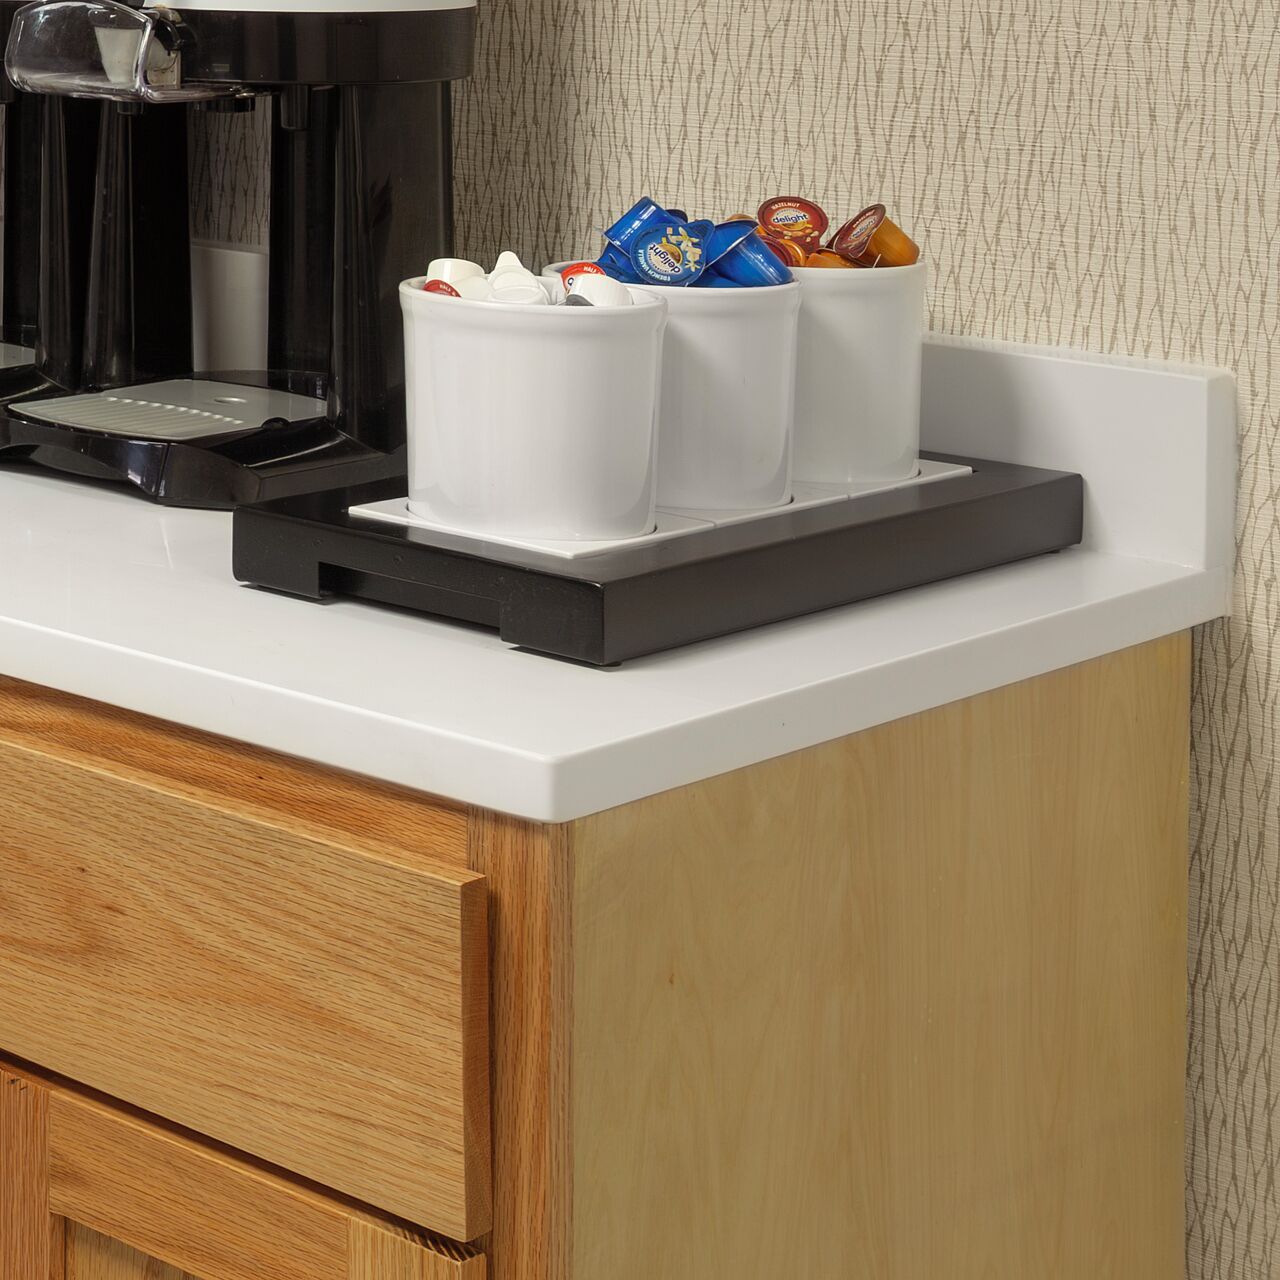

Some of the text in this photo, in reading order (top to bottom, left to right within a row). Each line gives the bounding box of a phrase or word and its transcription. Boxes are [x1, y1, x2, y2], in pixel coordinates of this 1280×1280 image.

[771, 202, 800, 210] HAZELNUT
[772, 214, 809, 224] delight
[648, 243, 681, 274] delight
